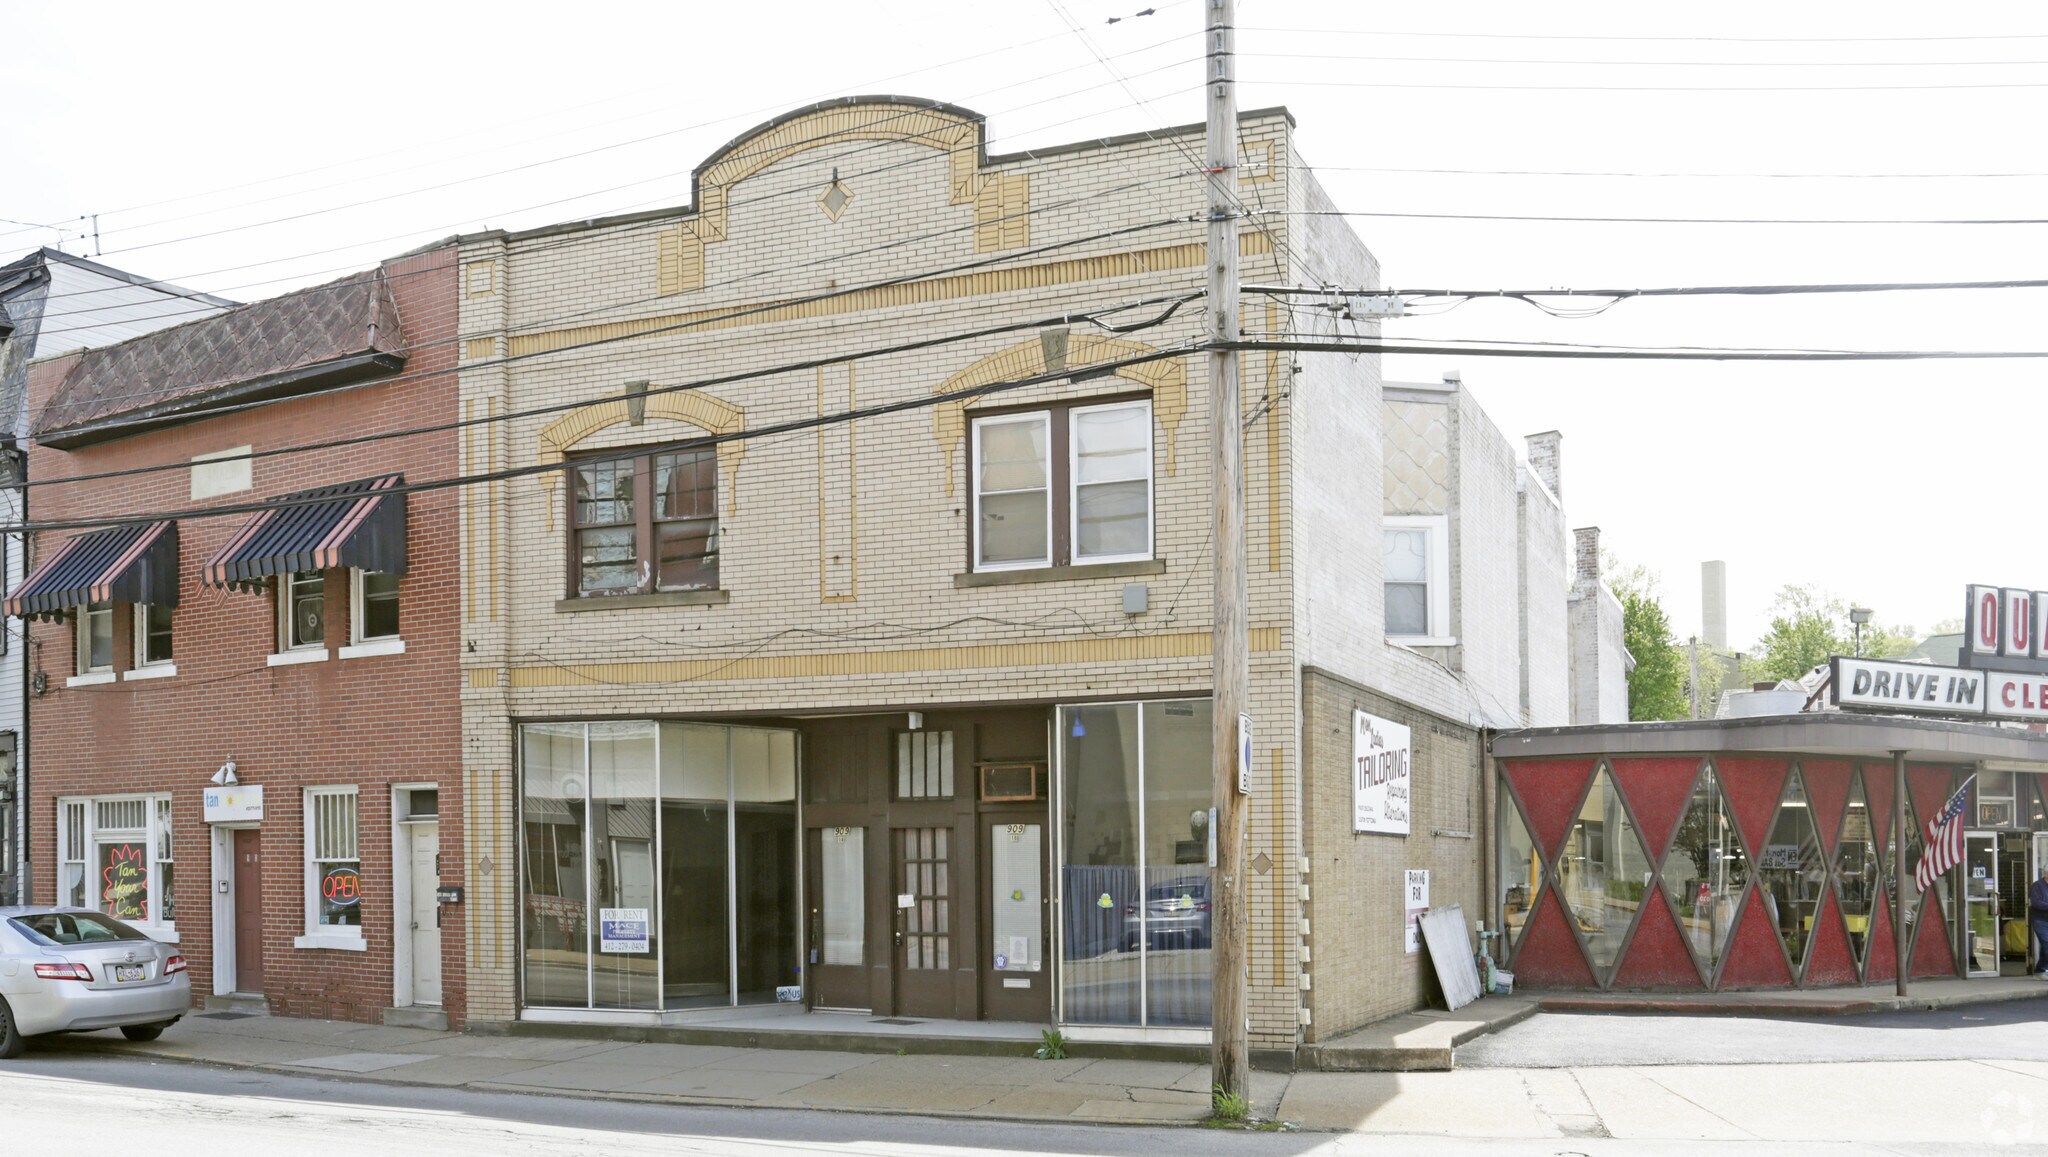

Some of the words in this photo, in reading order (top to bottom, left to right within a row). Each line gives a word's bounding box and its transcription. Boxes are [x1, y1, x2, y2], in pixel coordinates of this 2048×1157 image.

[1981, 592, 2048, 651] QU
[1852, 668, 1939, 701] DRIVE
[1945, 676, 1978, 704] IN
[1358, 748, 1407, 790] TAILORING
[206, 793, 219, 807] tan
[835, 827, 849, 835] 909
[1007, 824, 1023, 833] 909
[115, 861, 138, 876] Tan
[1409, 871, 1425, 886] PARKING
[114, 878, 139, 899] Your
[323, 875, 361, 898] OPEN
[1412, 886, 1421, 901] FOR
[116, 897, 141, 915] Can
[604, 910, 620, 920] FOR
[623, 910, 644, 920] RENT
[608, 922, 640, 930] MACE
